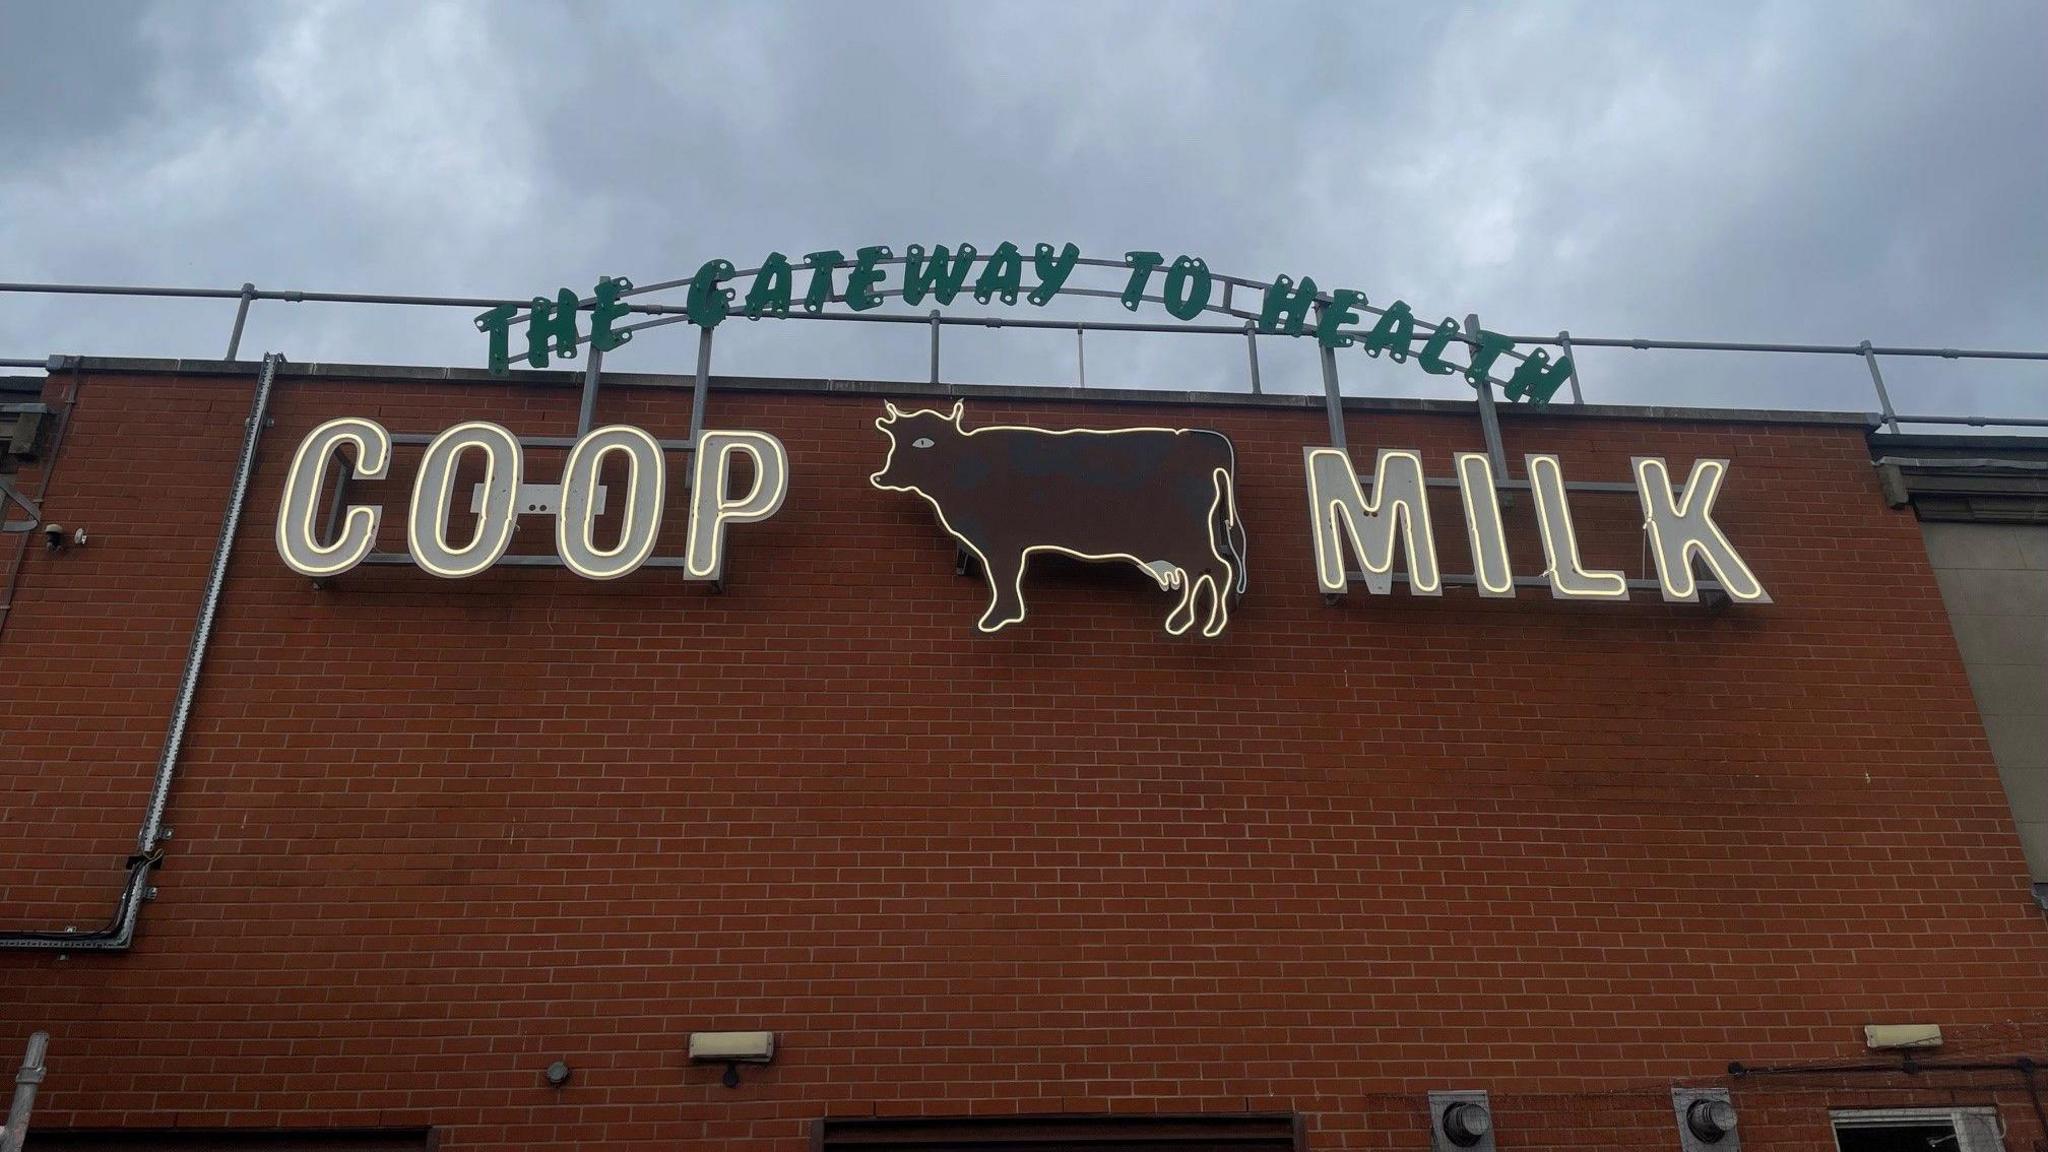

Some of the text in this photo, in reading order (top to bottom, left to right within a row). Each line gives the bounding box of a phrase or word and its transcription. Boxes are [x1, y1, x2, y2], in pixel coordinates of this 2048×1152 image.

[473, 241, 1573, 408] THE GATEWAY TO HEALTH
[1302, 446, 1774, 604] MILK
